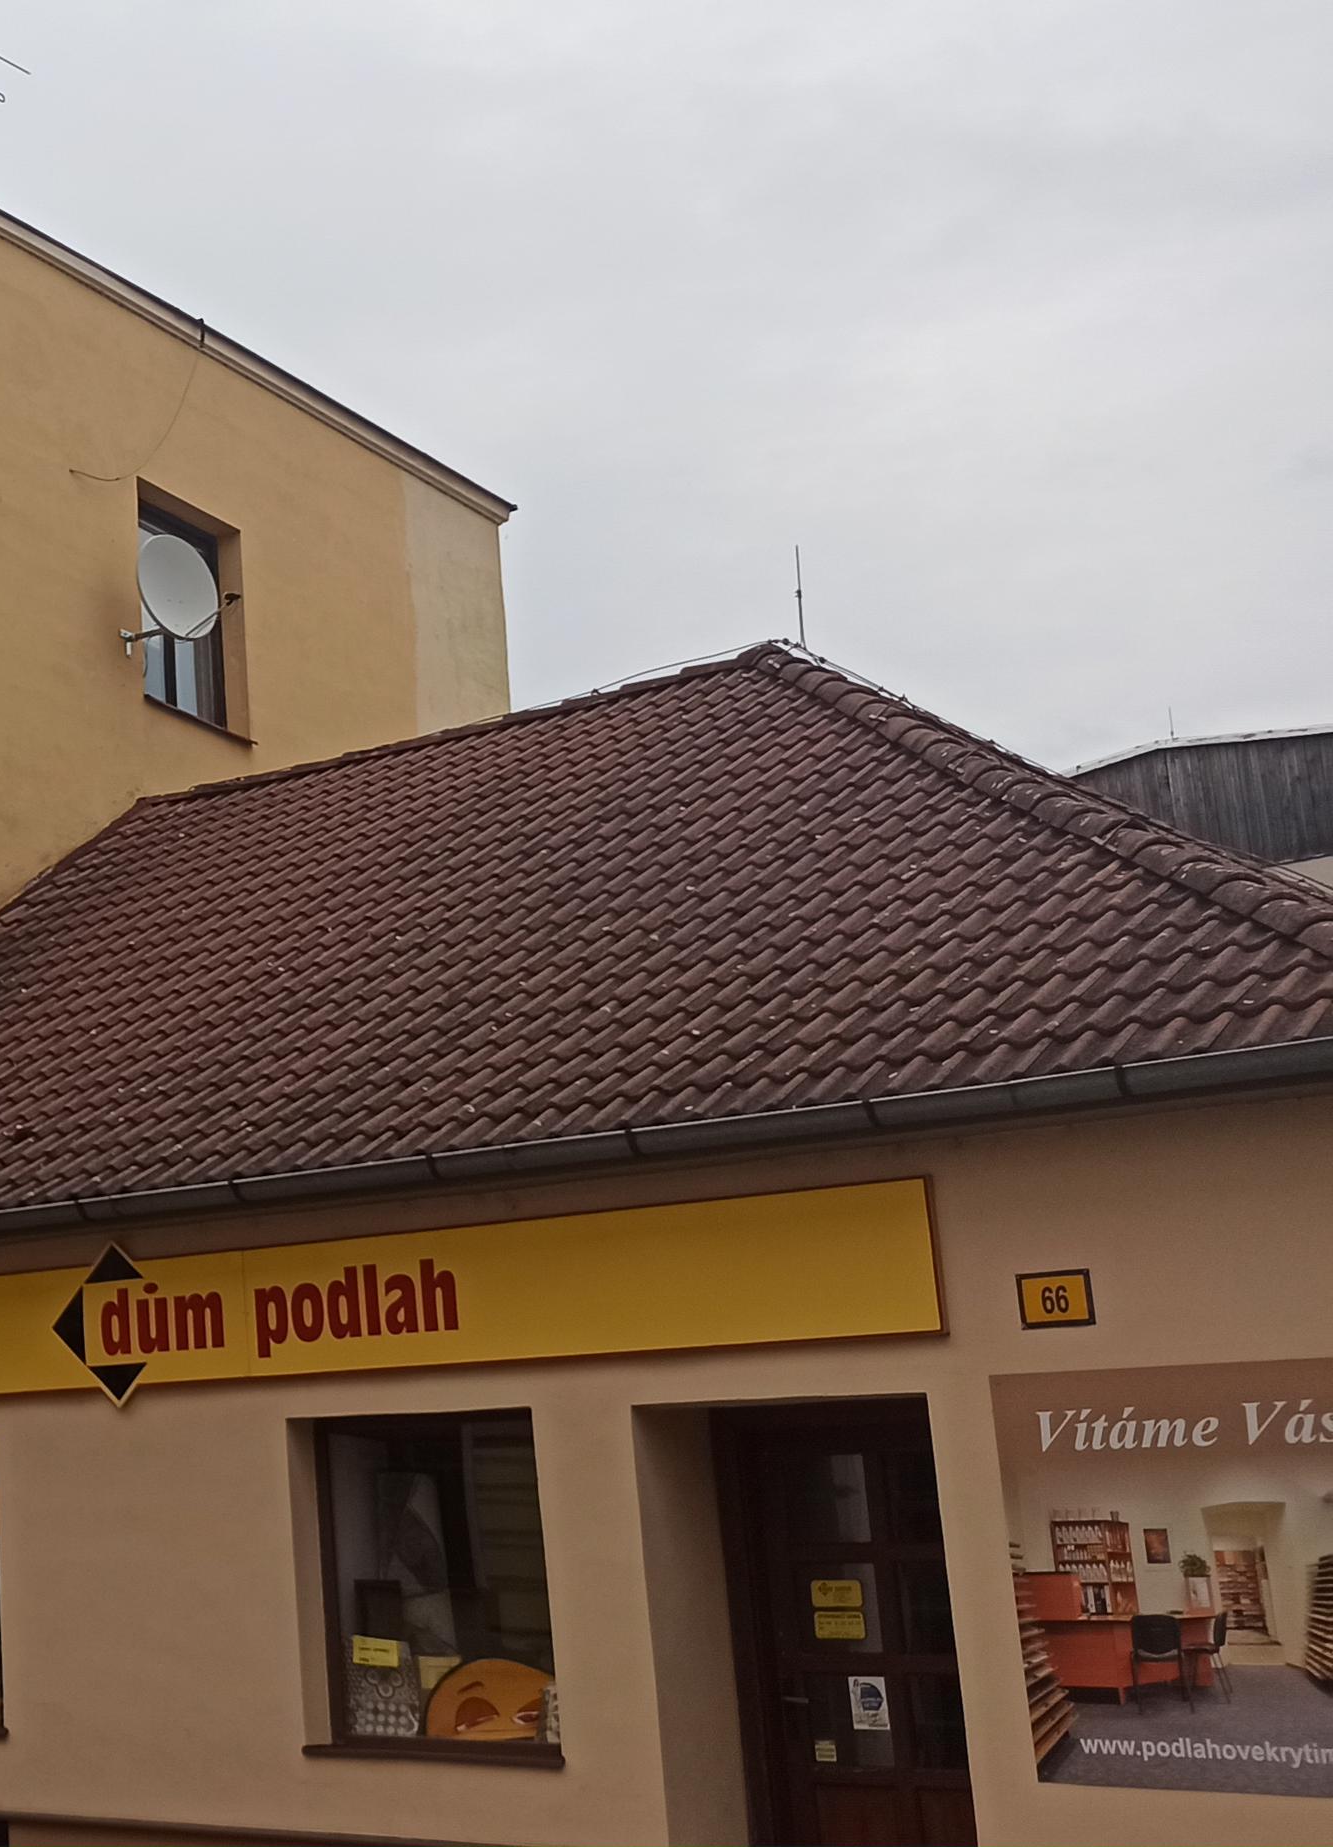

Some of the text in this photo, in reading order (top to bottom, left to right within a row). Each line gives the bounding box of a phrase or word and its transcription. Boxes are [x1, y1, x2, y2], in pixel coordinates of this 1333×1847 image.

[100, 1258, 460, 1359] dům podlah
[1041, 1285, 1070, 1314] 66
[1036, 1407, 1220, 1452] Vítáme
